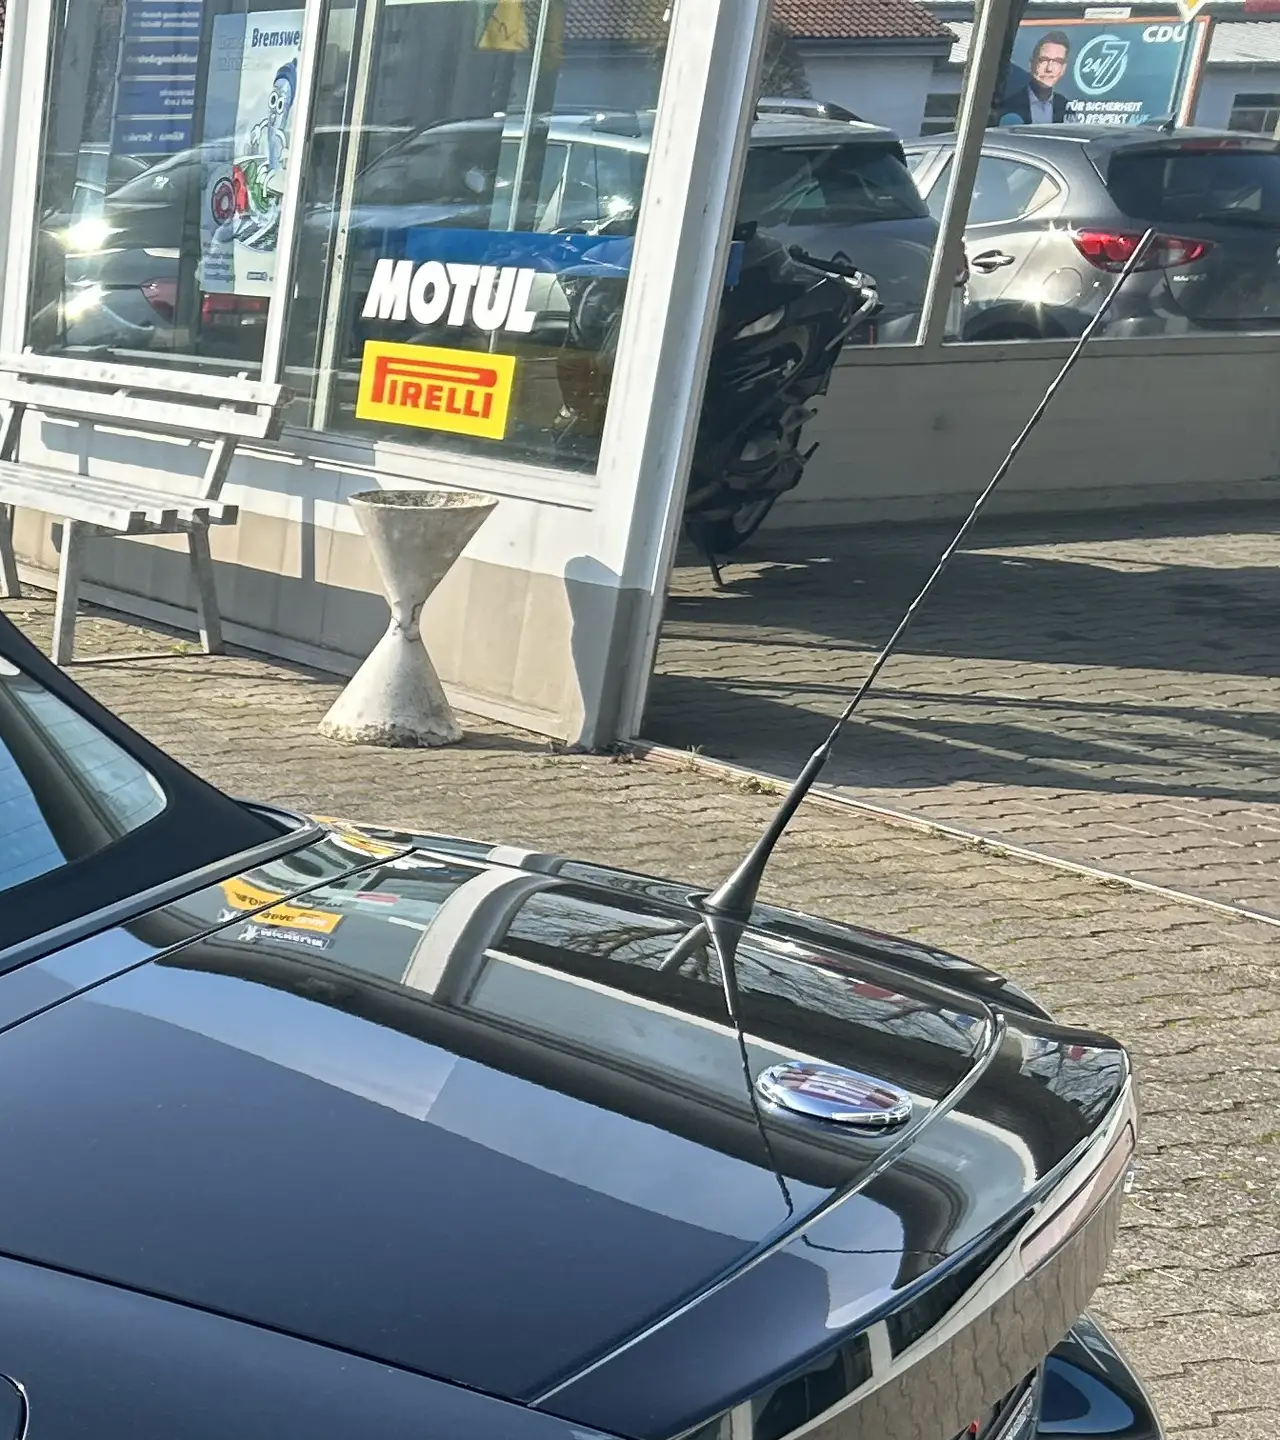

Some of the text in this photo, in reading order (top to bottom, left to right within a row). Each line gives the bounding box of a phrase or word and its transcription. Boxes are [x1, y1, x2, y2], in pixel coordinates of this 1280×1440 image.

[1142, 25, 1188, 43] CDU
[1065, 98, 1143, 112] FÜR SICHERHEIT
[1085, 112, 1128, 124] RESPEKT
[362, 258, 538, 334] MOTUL
[371, 355, 498, 420] PIRELLI
